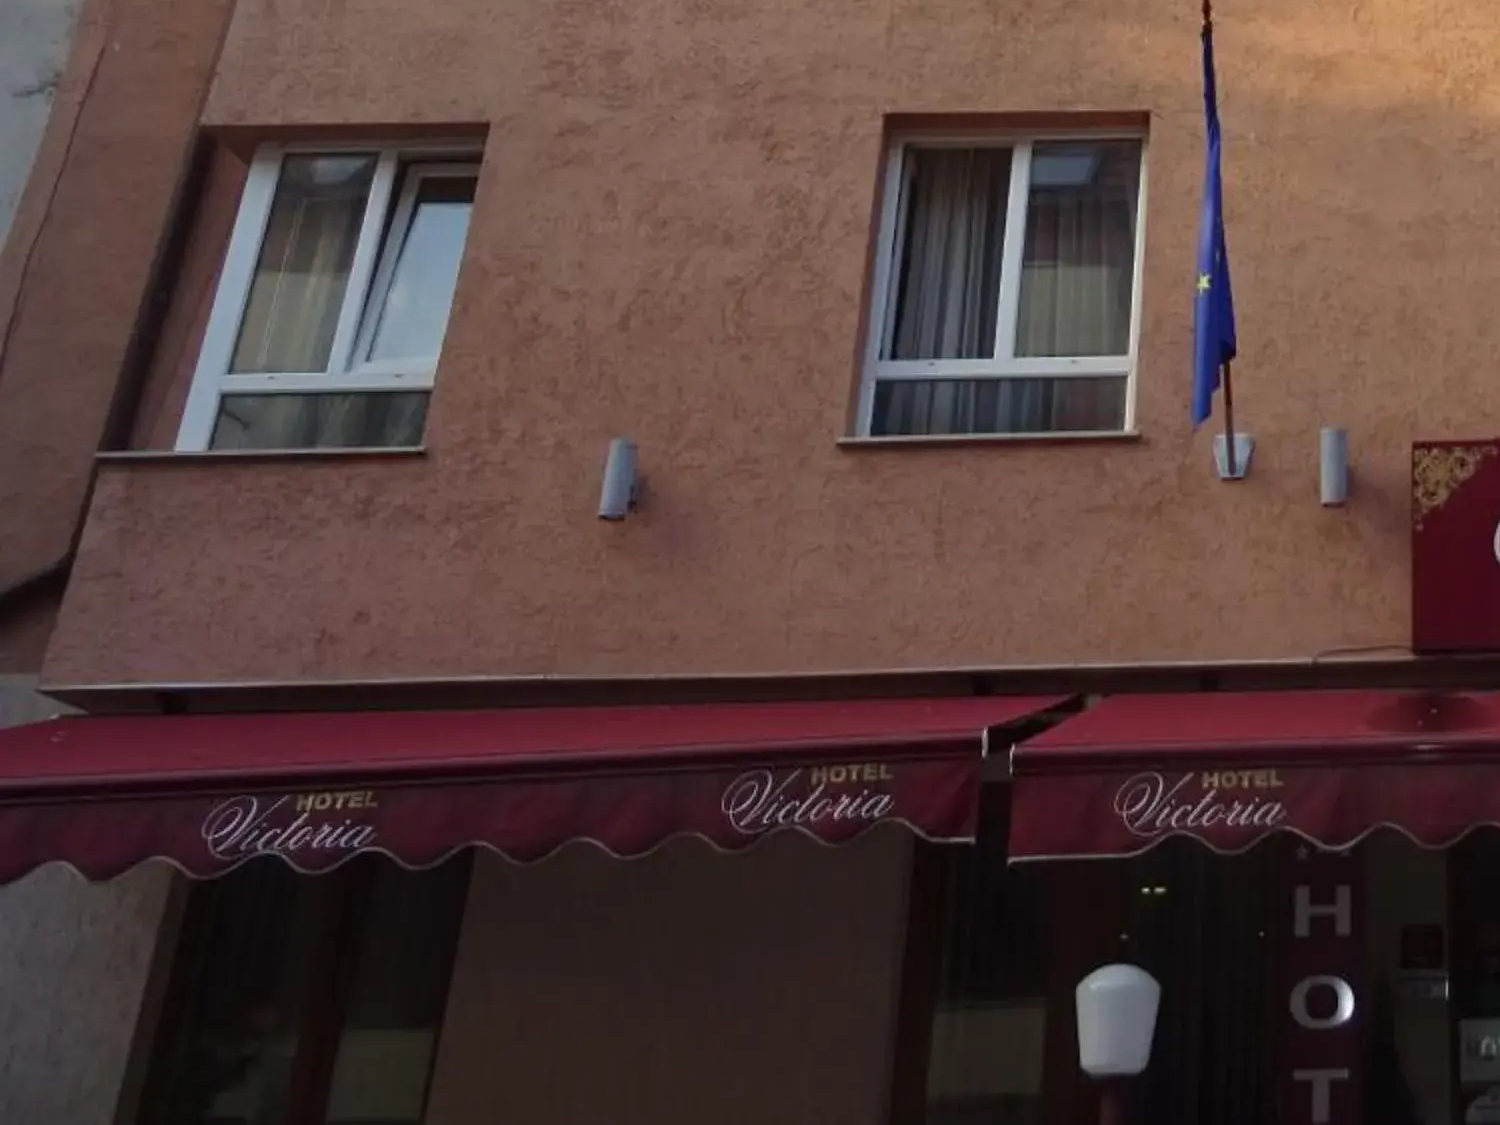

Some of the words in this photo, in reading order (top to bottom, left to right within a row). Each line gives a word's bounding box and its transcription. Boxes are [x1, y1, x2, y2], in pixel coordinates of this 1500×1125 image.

[811, 763, 893, 785] HOTEL
[1202, 769, 1284, 789] HOTEL
[295, 789, 379, 811] HOTEL
[720, 769, 895, 834] Victoria
[1114, 772, 1287, 838] Victoria
[201, 795, 379, 860] Victoria
